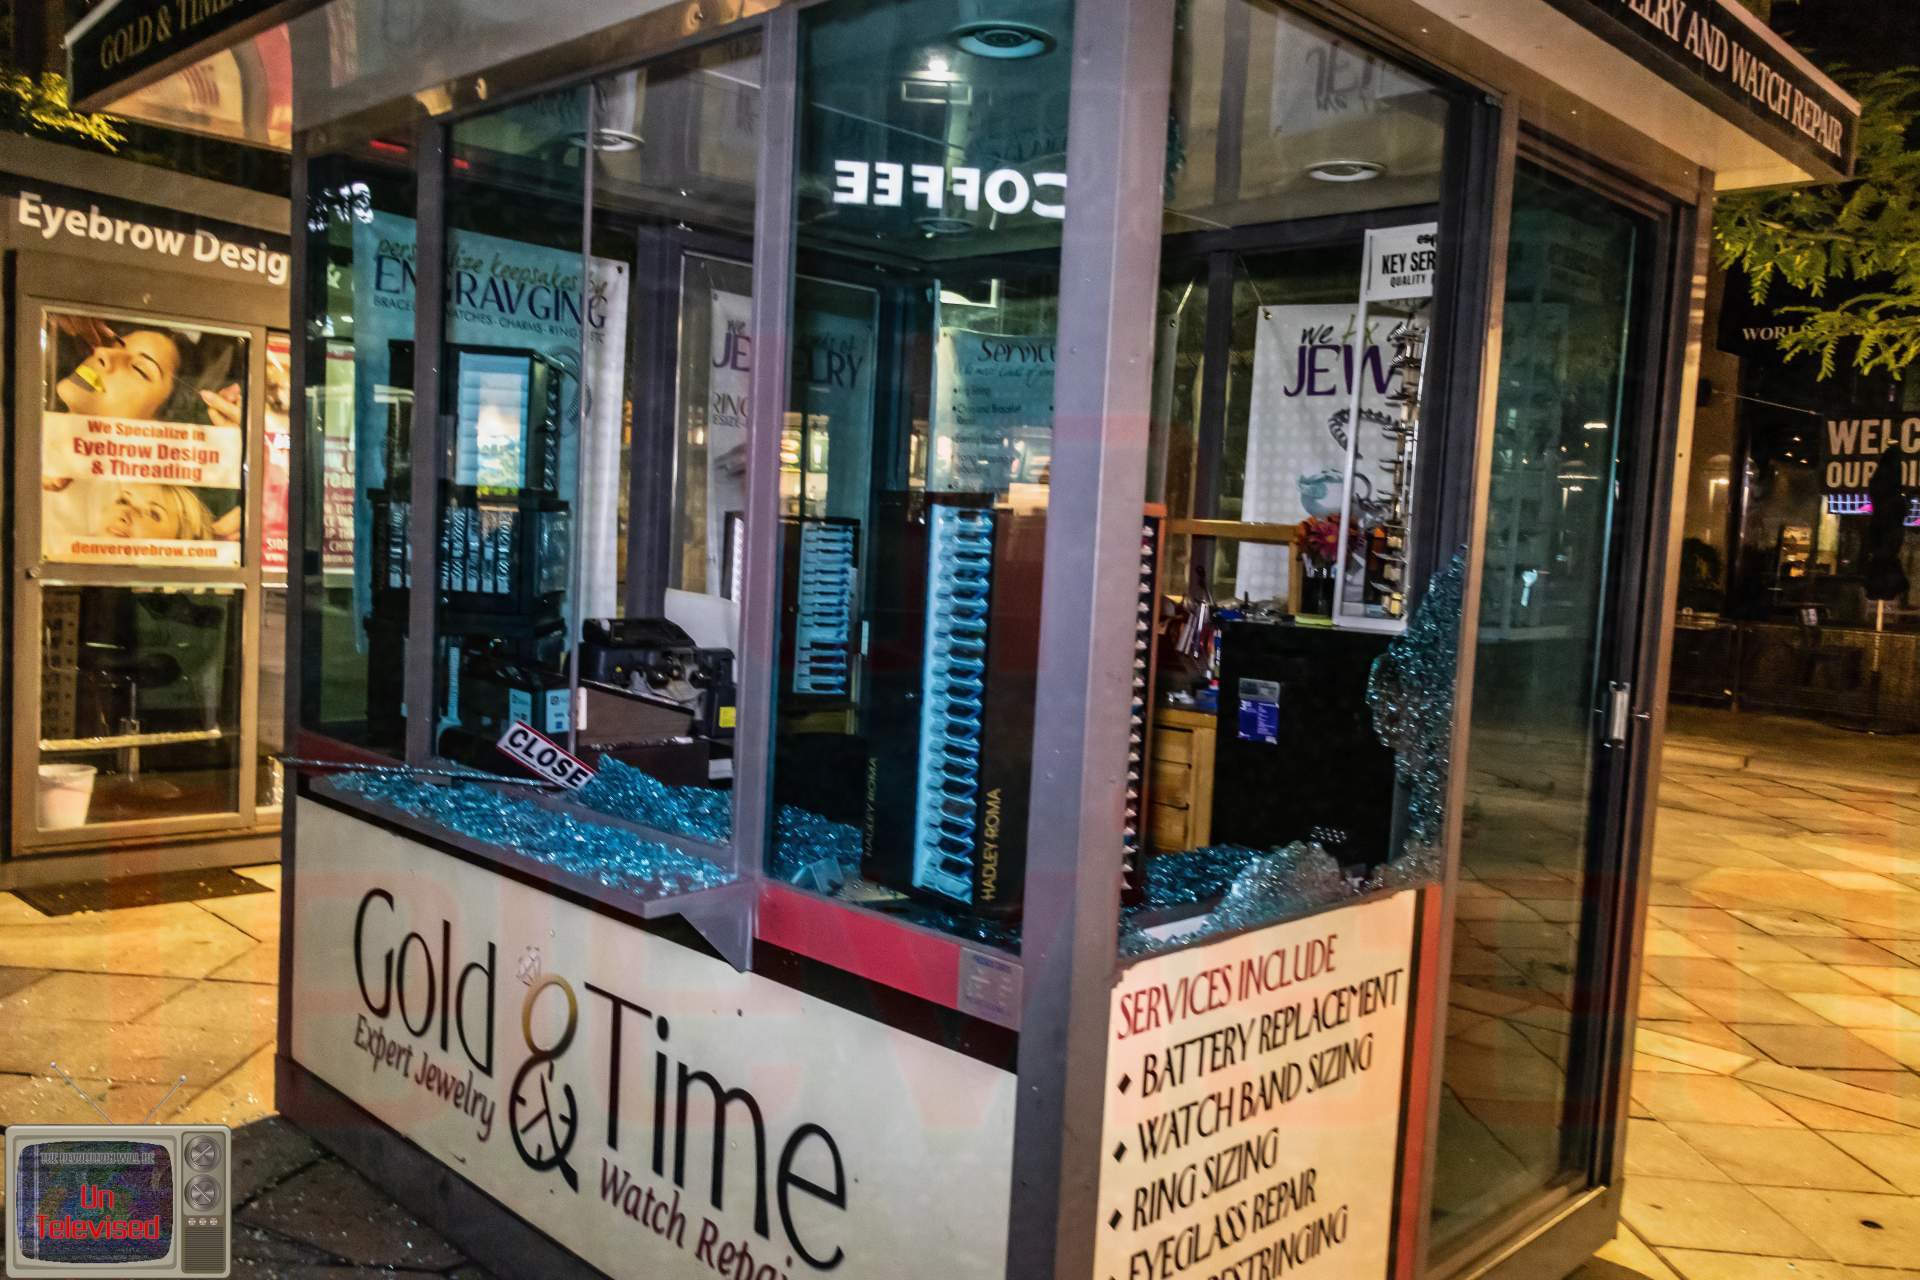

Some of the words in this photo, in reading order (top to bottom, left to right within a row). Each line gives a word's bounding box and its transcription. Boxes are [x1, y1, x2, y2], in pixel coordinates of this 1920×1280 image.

[101, 15, 152, 70] GOLD
[156, 4, 173, 43] &
[175, 0, 236, 31] TI
[1683, 10, 1729, 73] AND
[1730, 40, 1793, 121] WATCH
[1792, 87, 1844, 159] REPAIR
[18, 190, 188, 257] Eyebrow
[192, 228, 291, 286] Desig
[1381, 253, 1408, 275] KEY
[374, 253, 609, 330] ENRAVGING
[1389, 273, 1426, 289] QUALITY
[548, 323, 584, 341] RING
[1301, 324, 1334, 345] we
[1341, 313, 1380, 346] fx
[73, 437, 153, 458] Eyebrow
[157, 443, 220, 465] Design
[87, 419, 112, 435] We
[116, 422, 189, 442] Specialize
[91, 459, 105, 476] &
[108, 459, 203, 482] Threading
[71, 540, 218, 559] denvereyebrow.com
[507, 728, 590, 788] CLOSE
[983, 787, 1002, 840] ROMA
[979, 842, 999, 901] HADLEY
[1117, 963, 1233, 1041] SERVICES
[1237, 934, 1339, 1002] INCLUDE
[1141, 1018, 1256, 1099] BATTERY
[1258, 967, 1405, 1056] REPLACEMENT
[353, 1012, 414, 1079] Expert
[414, 1051, 497, 1143] Jewelry
[353, 886, 498, 1079] Gold
[583, 980, 847, 1272] Time
[1137, 1086, 1234, 1163] WATCH
[1239, 1061, 1303, 1121] BAND
[1306, 1032, 1374, 1093] SIZING
[600, 1156, 687, 1250] Watch
[1132, 1163, 1199, 1232] RING
[1200, 1126, 1280, 1199] SIZING
[1128, 1200, 1248, 1280] EYEGLASS
[1250, 1167, 1318, 1234] REPAIR
[1206, 1203, 1348, 1280] TRINGING
